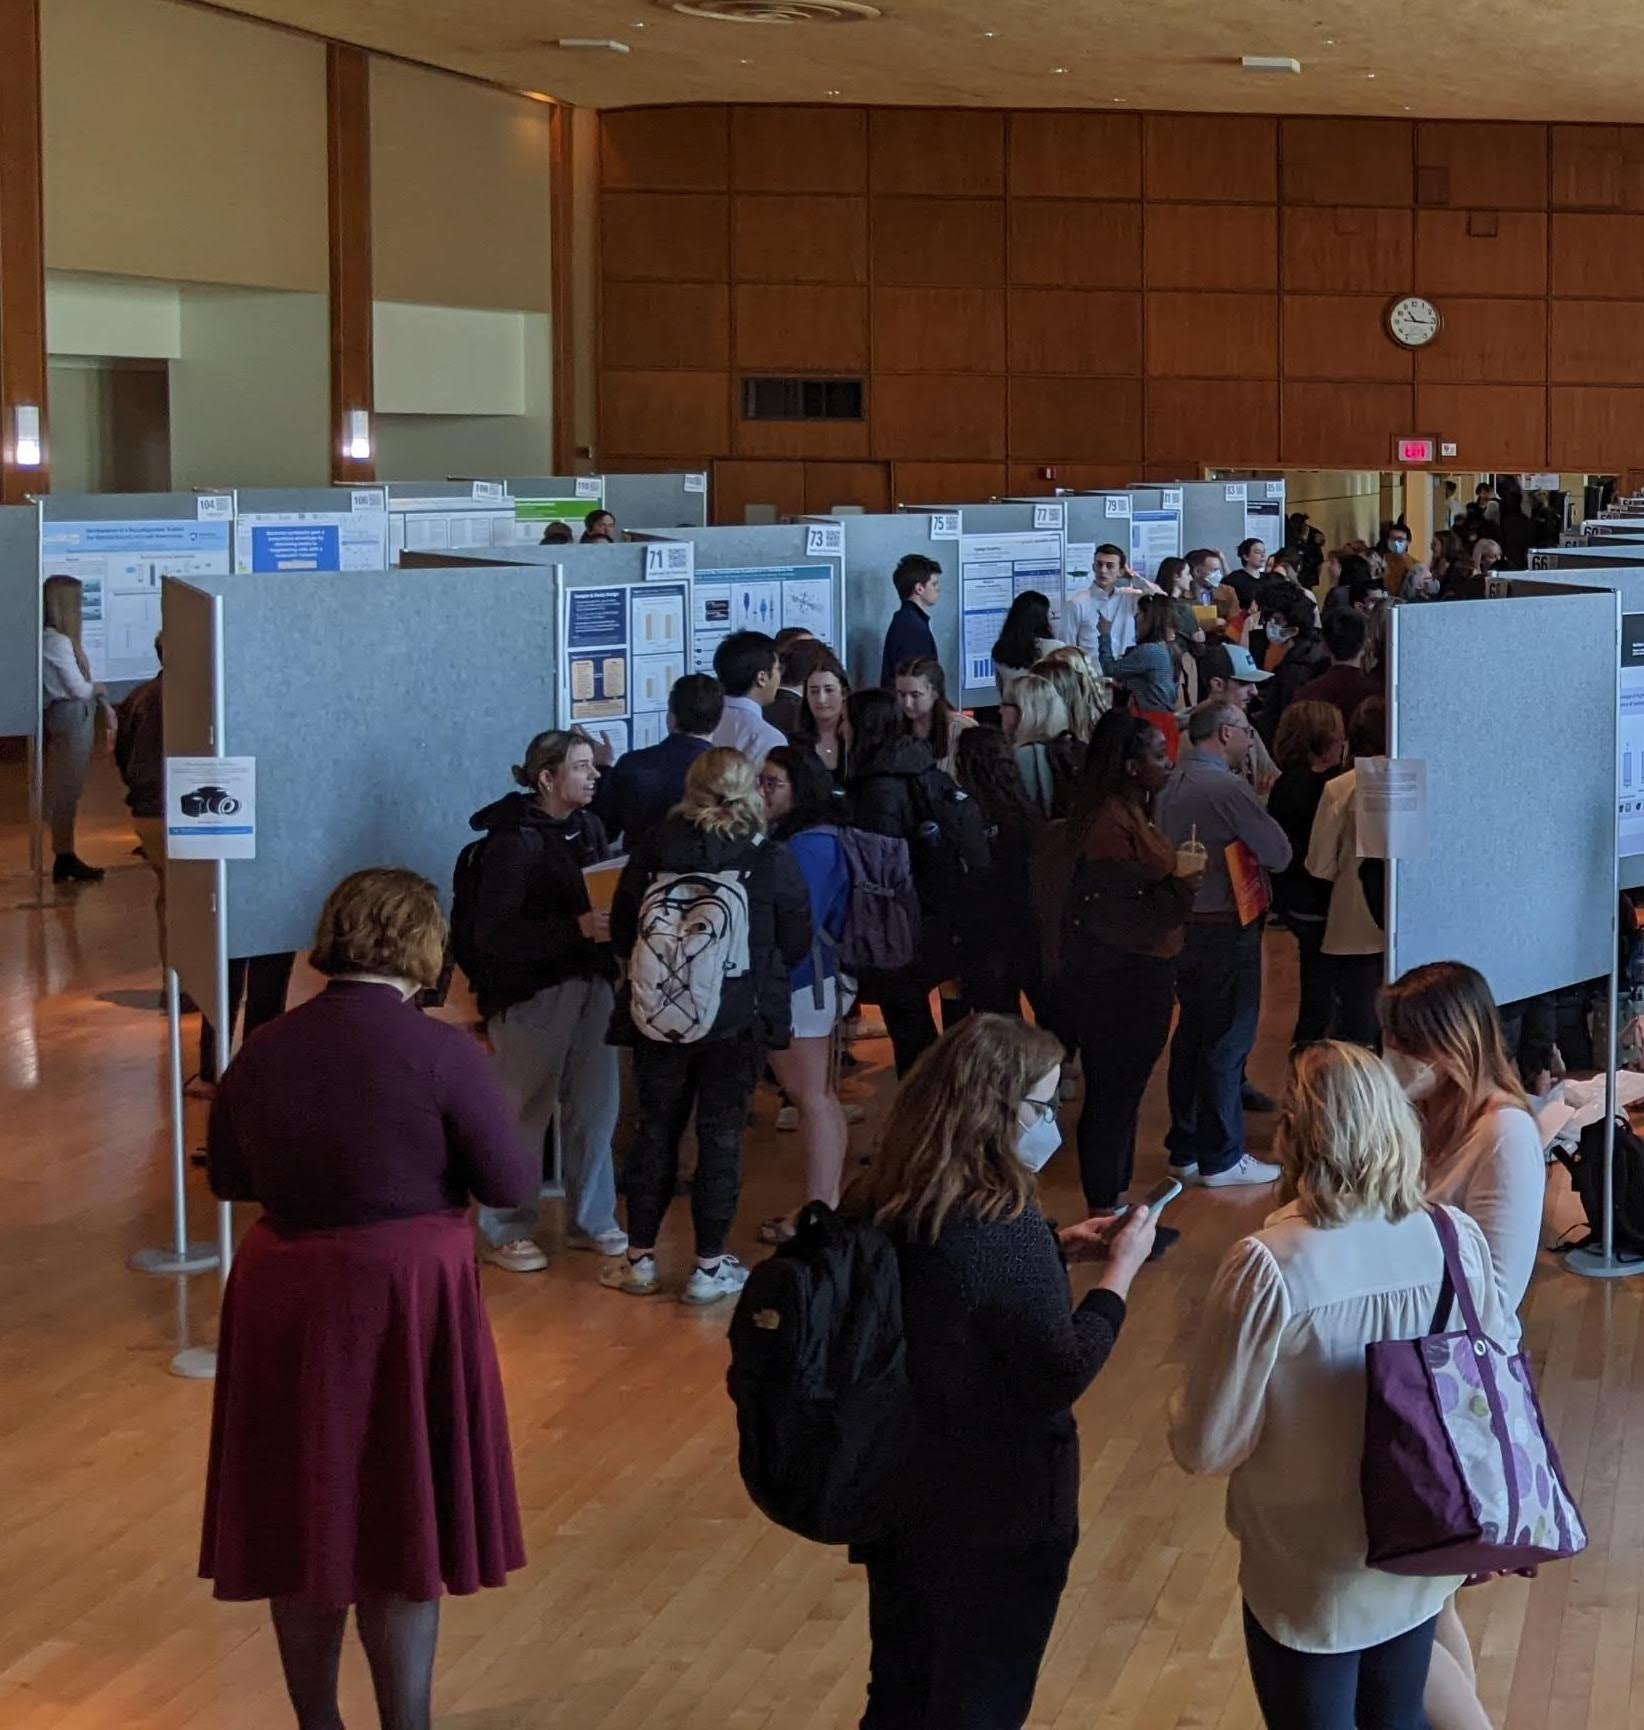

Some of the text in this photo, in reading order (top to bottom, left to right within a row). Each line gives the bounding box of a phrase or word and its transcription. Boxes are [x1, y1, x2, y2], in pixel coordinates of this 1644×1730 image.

[200, 500, 215, 510] 104
[1107, 500, 1117, 511] 79
[1037, 508, 1048, 521] 77
[934, 516, 944, 530] 75
[810, 530, 823, 546] 73
[649, 550, 662, 570] 71
[1532, 555, 1548, 570] 66
